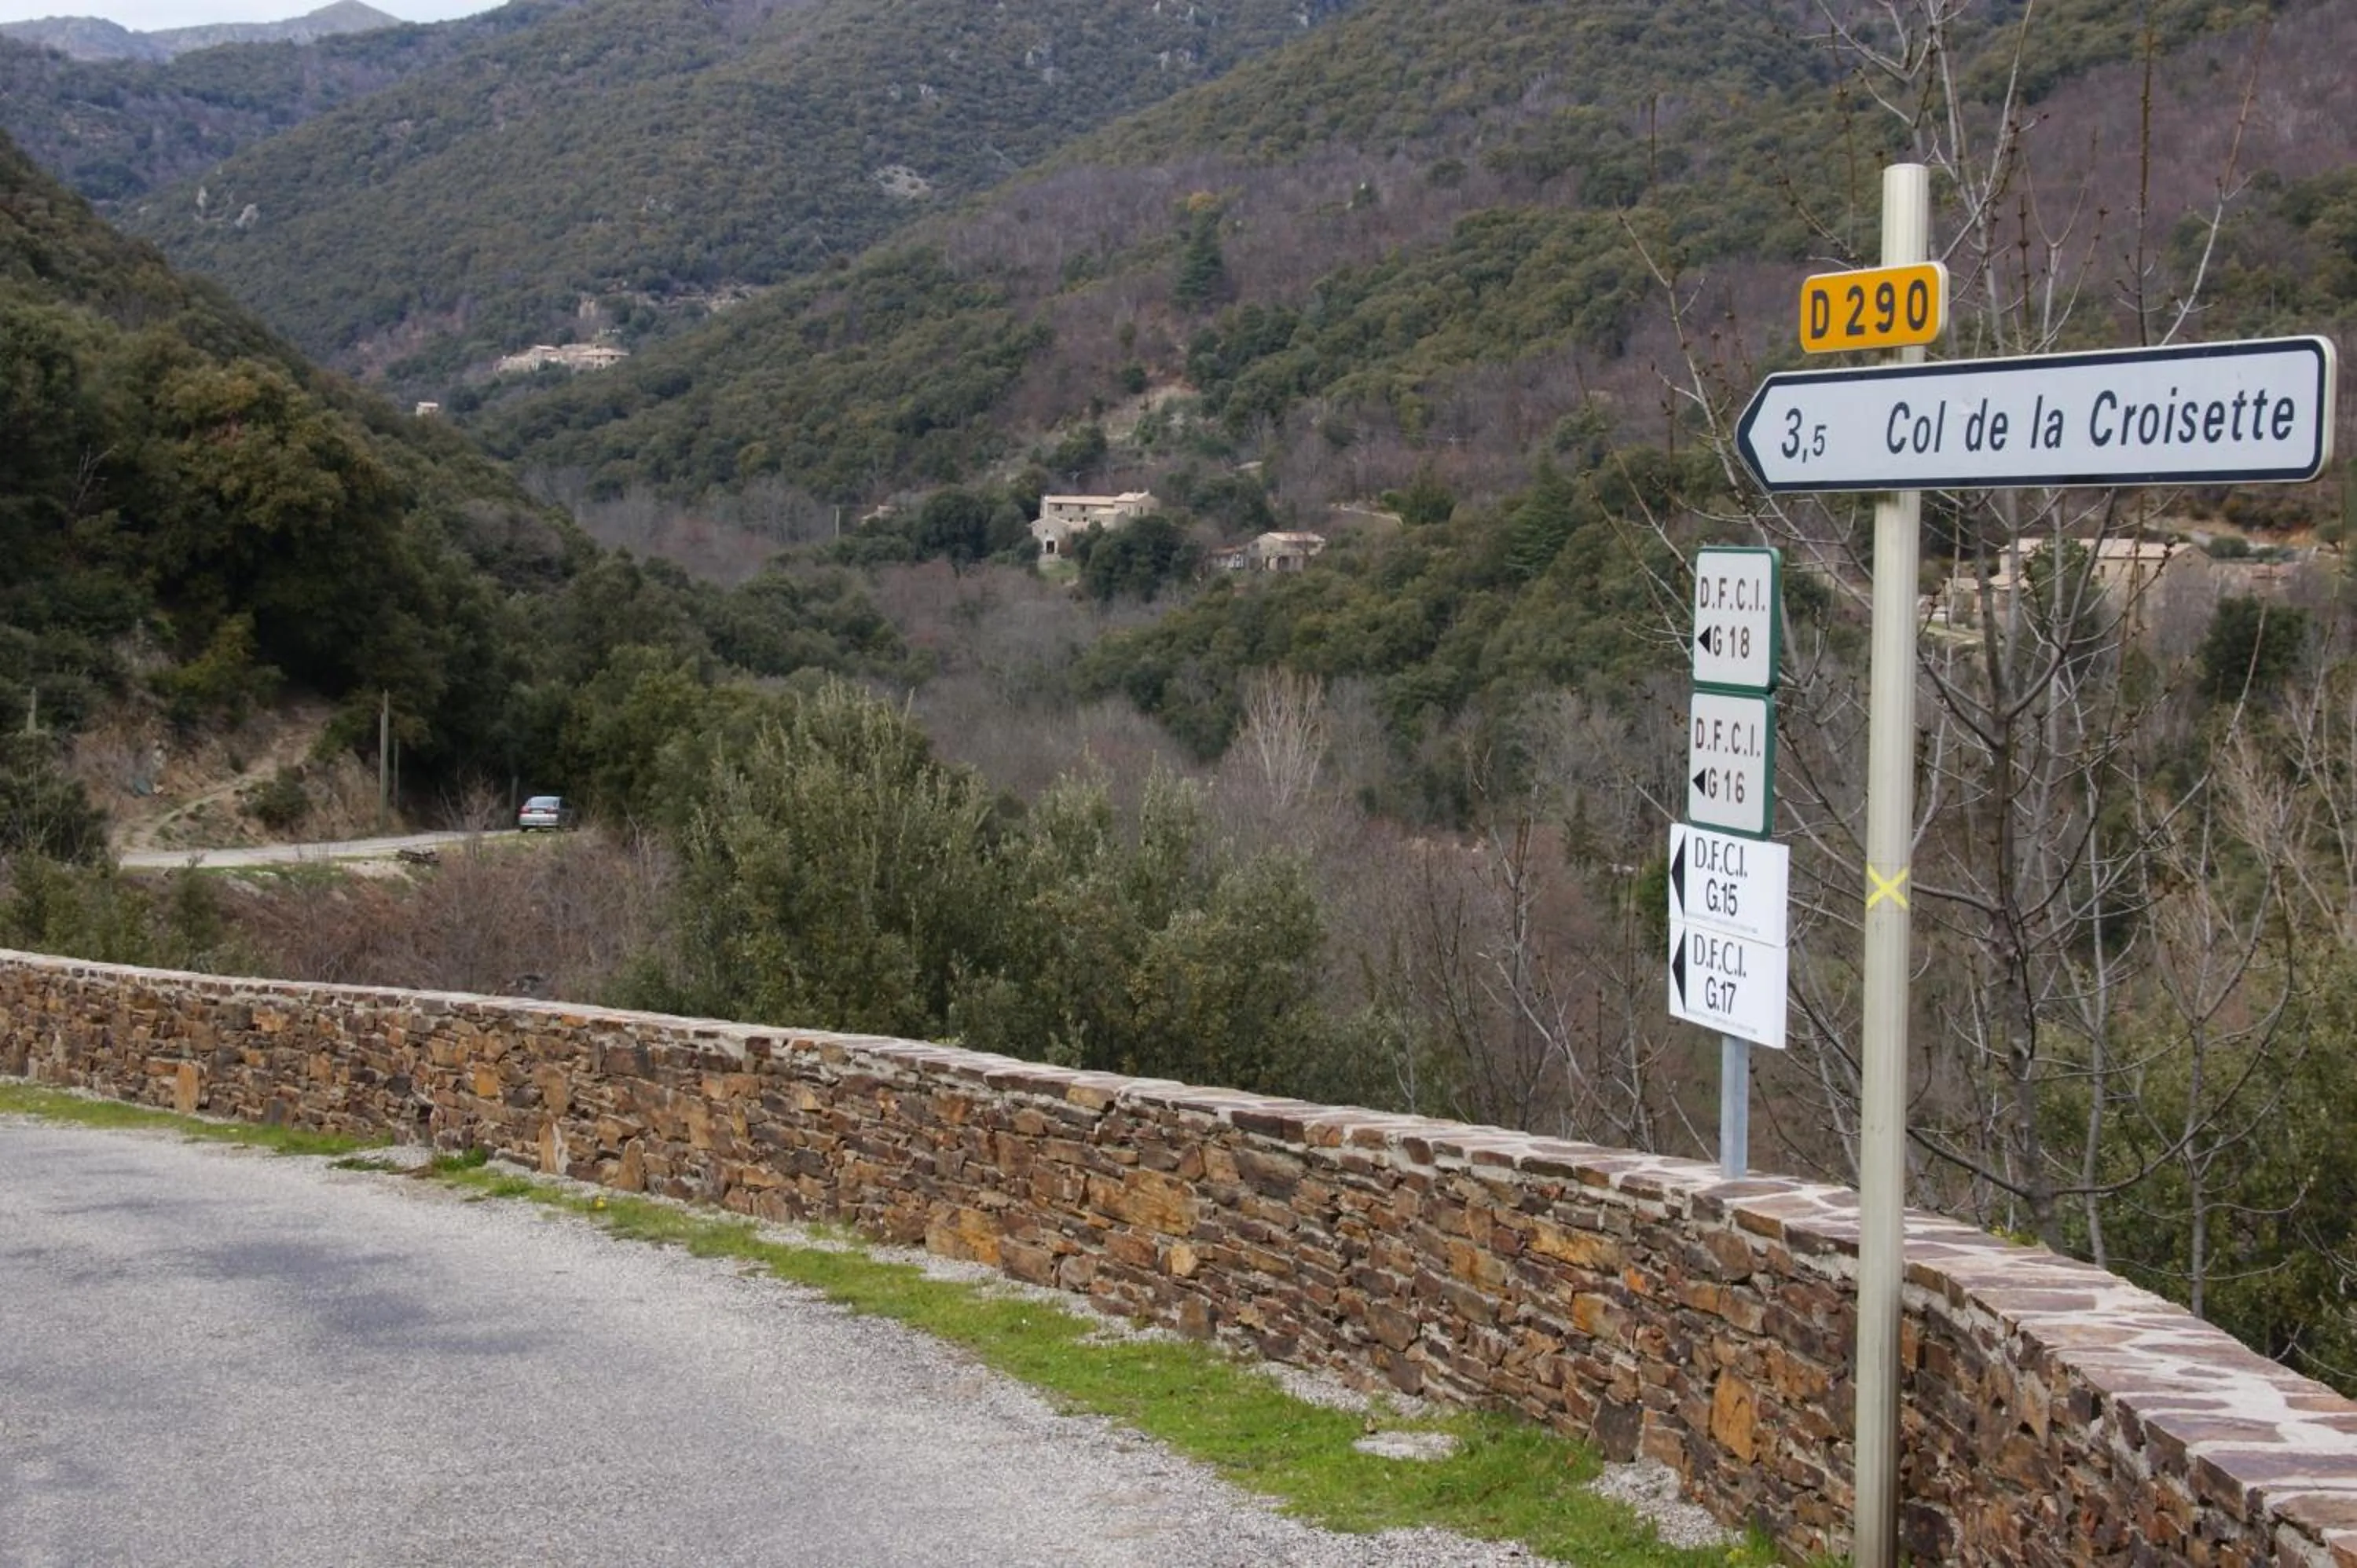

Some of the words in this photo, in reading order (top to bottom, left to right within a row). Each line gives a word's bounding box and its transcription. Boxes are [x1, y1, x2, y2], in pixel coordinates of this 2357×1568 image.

[1811, 289, 1830, 340] D
[1846, 279, 1929, 336] 290
[1781, 407, 1827, 463] 3,5
[1886, 400, 1946, 455] Col
[1965, 398, 2008, 452] de
[2030, 394, 2063, 449] la
[2090, 387, 2295, 447] Croisette
[1699, 577, 1765, 611] D.F.C.I.
[1713, 625, 1722, 657] G
[1730, 626, 1750, 659] 18
[1695, 717, 1761, 758] D.F.C.I.
[1708, 767, 1717, 800] G
[1725, 770, 1745, 804] 16
[1695, 837, 1748, 877] D.F.C.I.
[1706, 878, 1738, 918] G.15
[1693, 933, 1747, 978] D.F.C.I.
[1706, 976, 1737, 1014] G.17
